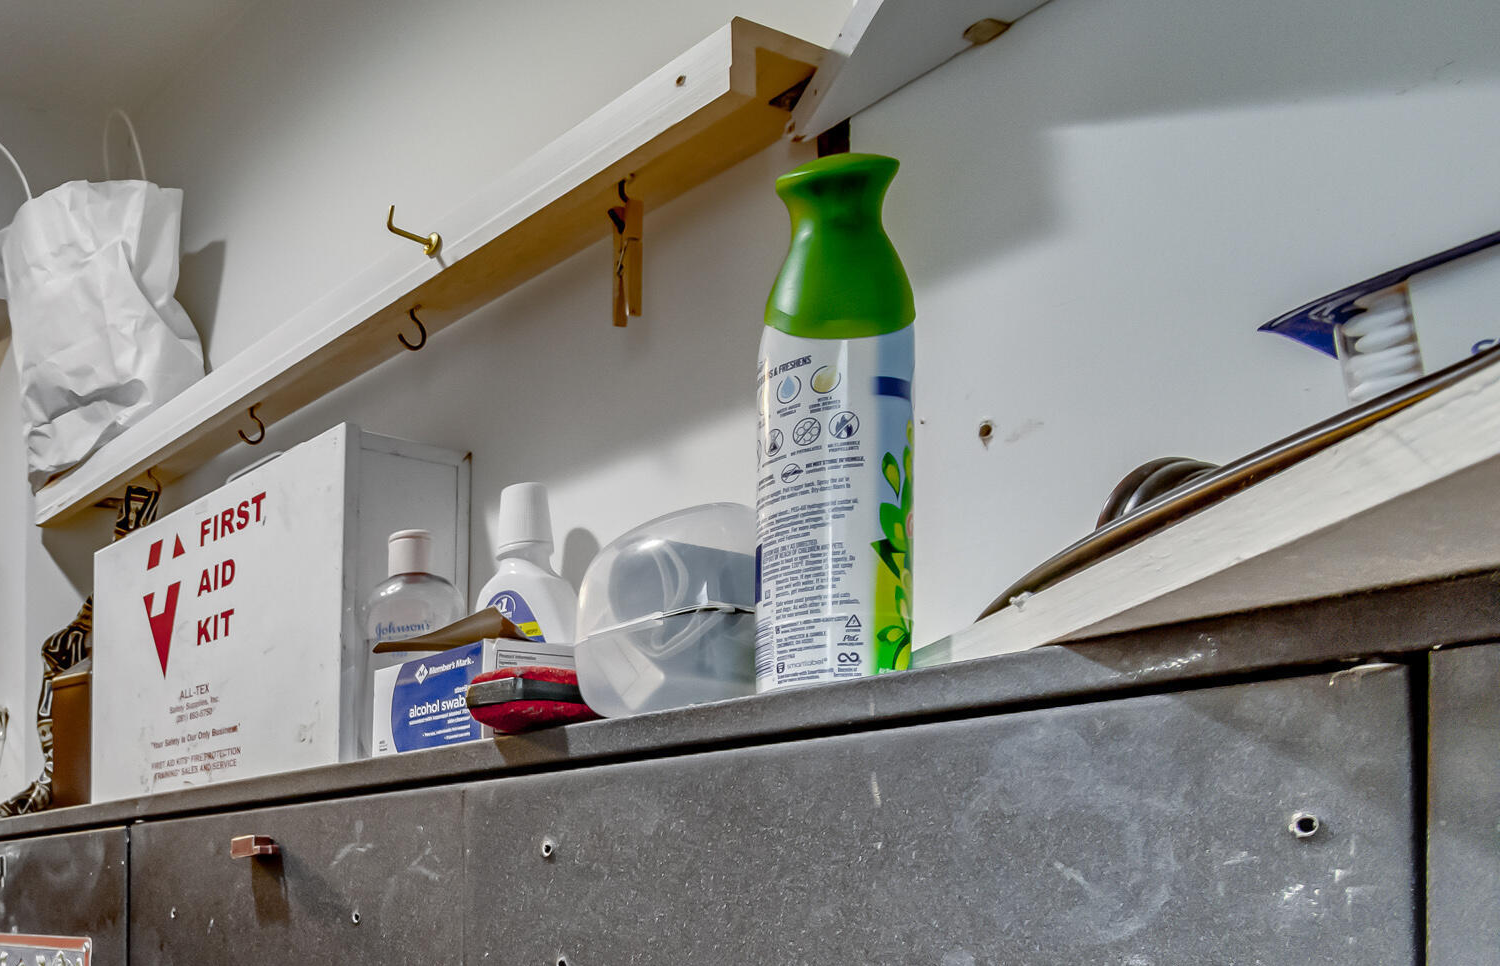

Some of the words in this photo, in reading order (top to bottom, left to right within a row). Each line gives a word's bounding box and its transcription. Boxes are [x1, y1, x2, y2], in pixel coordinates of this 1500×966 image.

[779, 355, 812, 374] FRESHENS
[200, 491, 266, 547] FIRST
[197, 558, 236, 597] AID
[197, 608, 235, 646] KIT
[375, 620, 430, 640] Johnson's
[429, 661, 455, 675] Member's
[179, 683, 210, 701] ALL-TEX
[409, 699, 440, 719] alcohol
[441, 694, 466, 711] swab
[203, 747, 241, 760] PROTECTION
[181, 765, 198, 775] SALES
[212, 759, 237, 770] SERVICE
